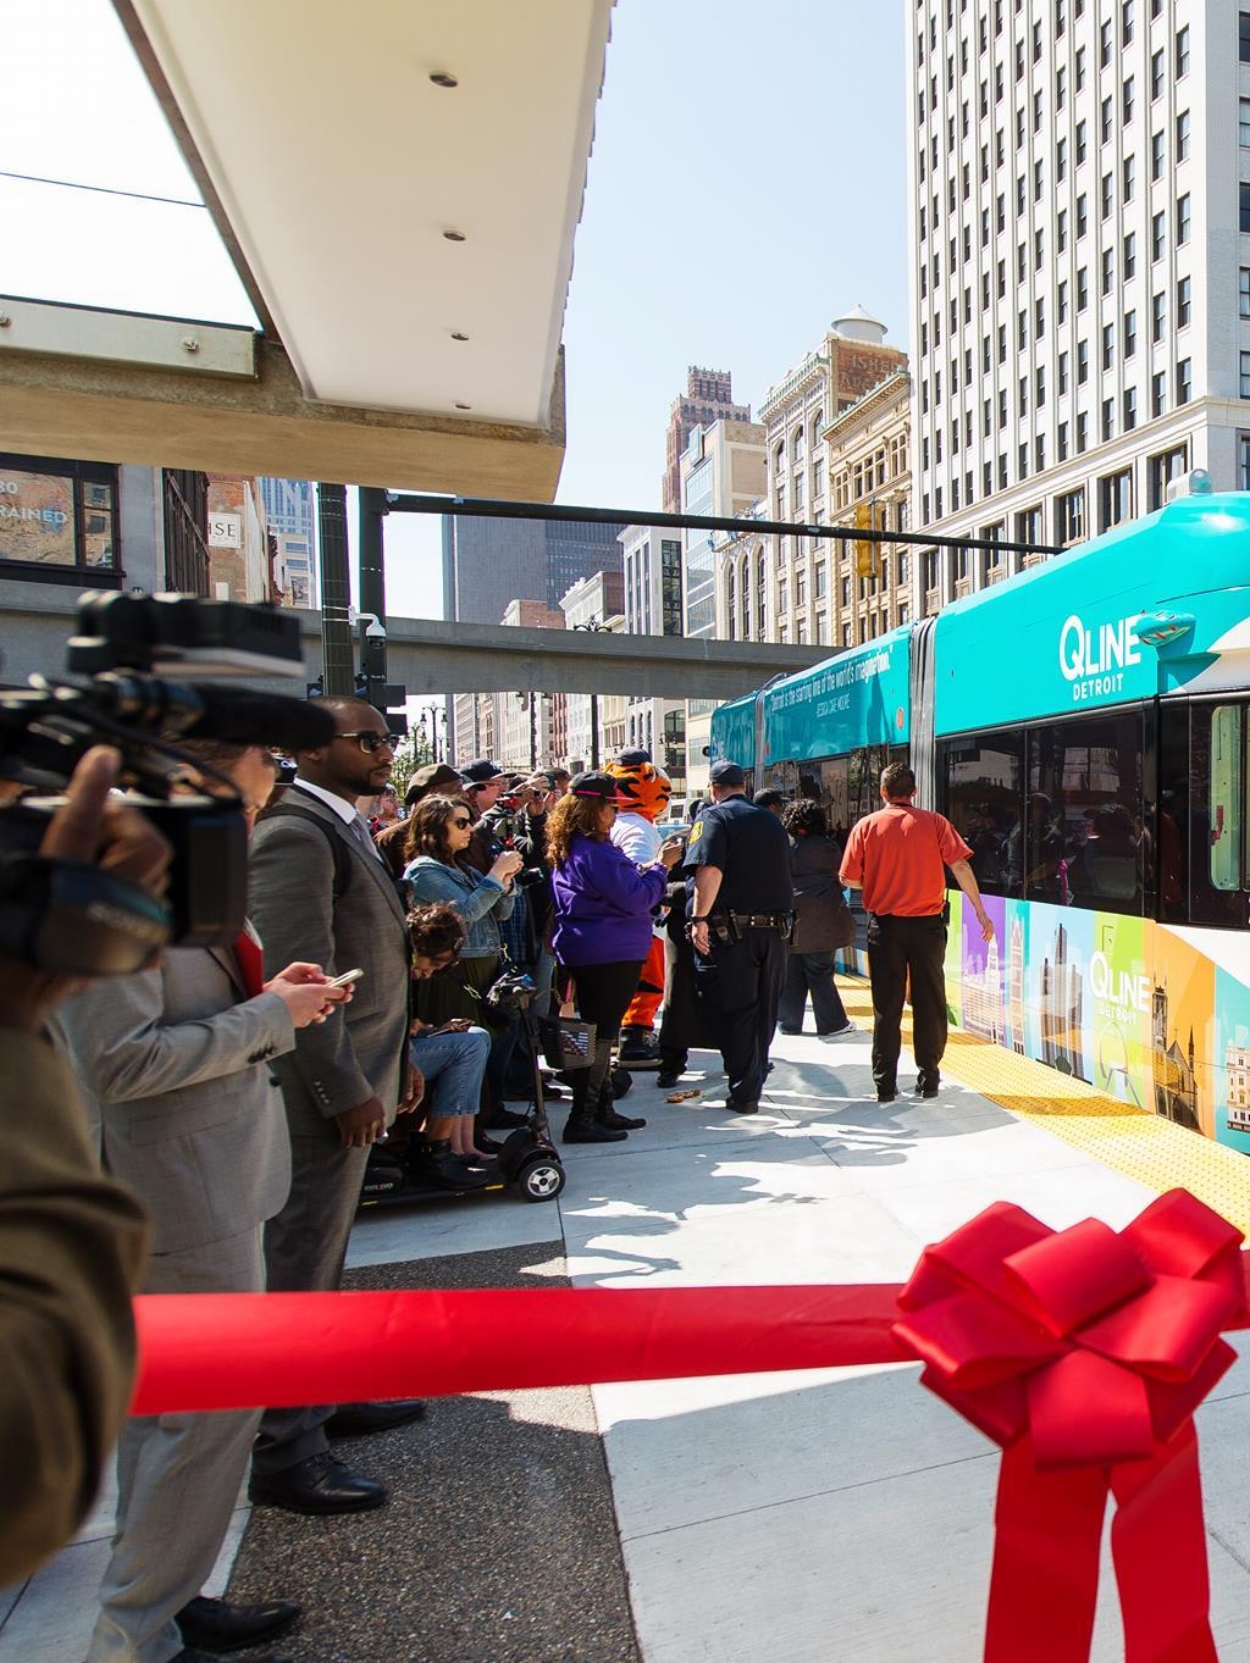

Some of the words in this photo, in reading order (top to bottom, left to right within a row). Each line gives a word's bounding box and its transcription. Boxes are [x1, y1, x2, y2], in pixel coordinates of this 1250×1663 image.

[1059, 614, 1142, 681] QLINE
[1073, 673, 1124, 701] DETROIT
[1089, 951, 1151, 1013] QLINE
